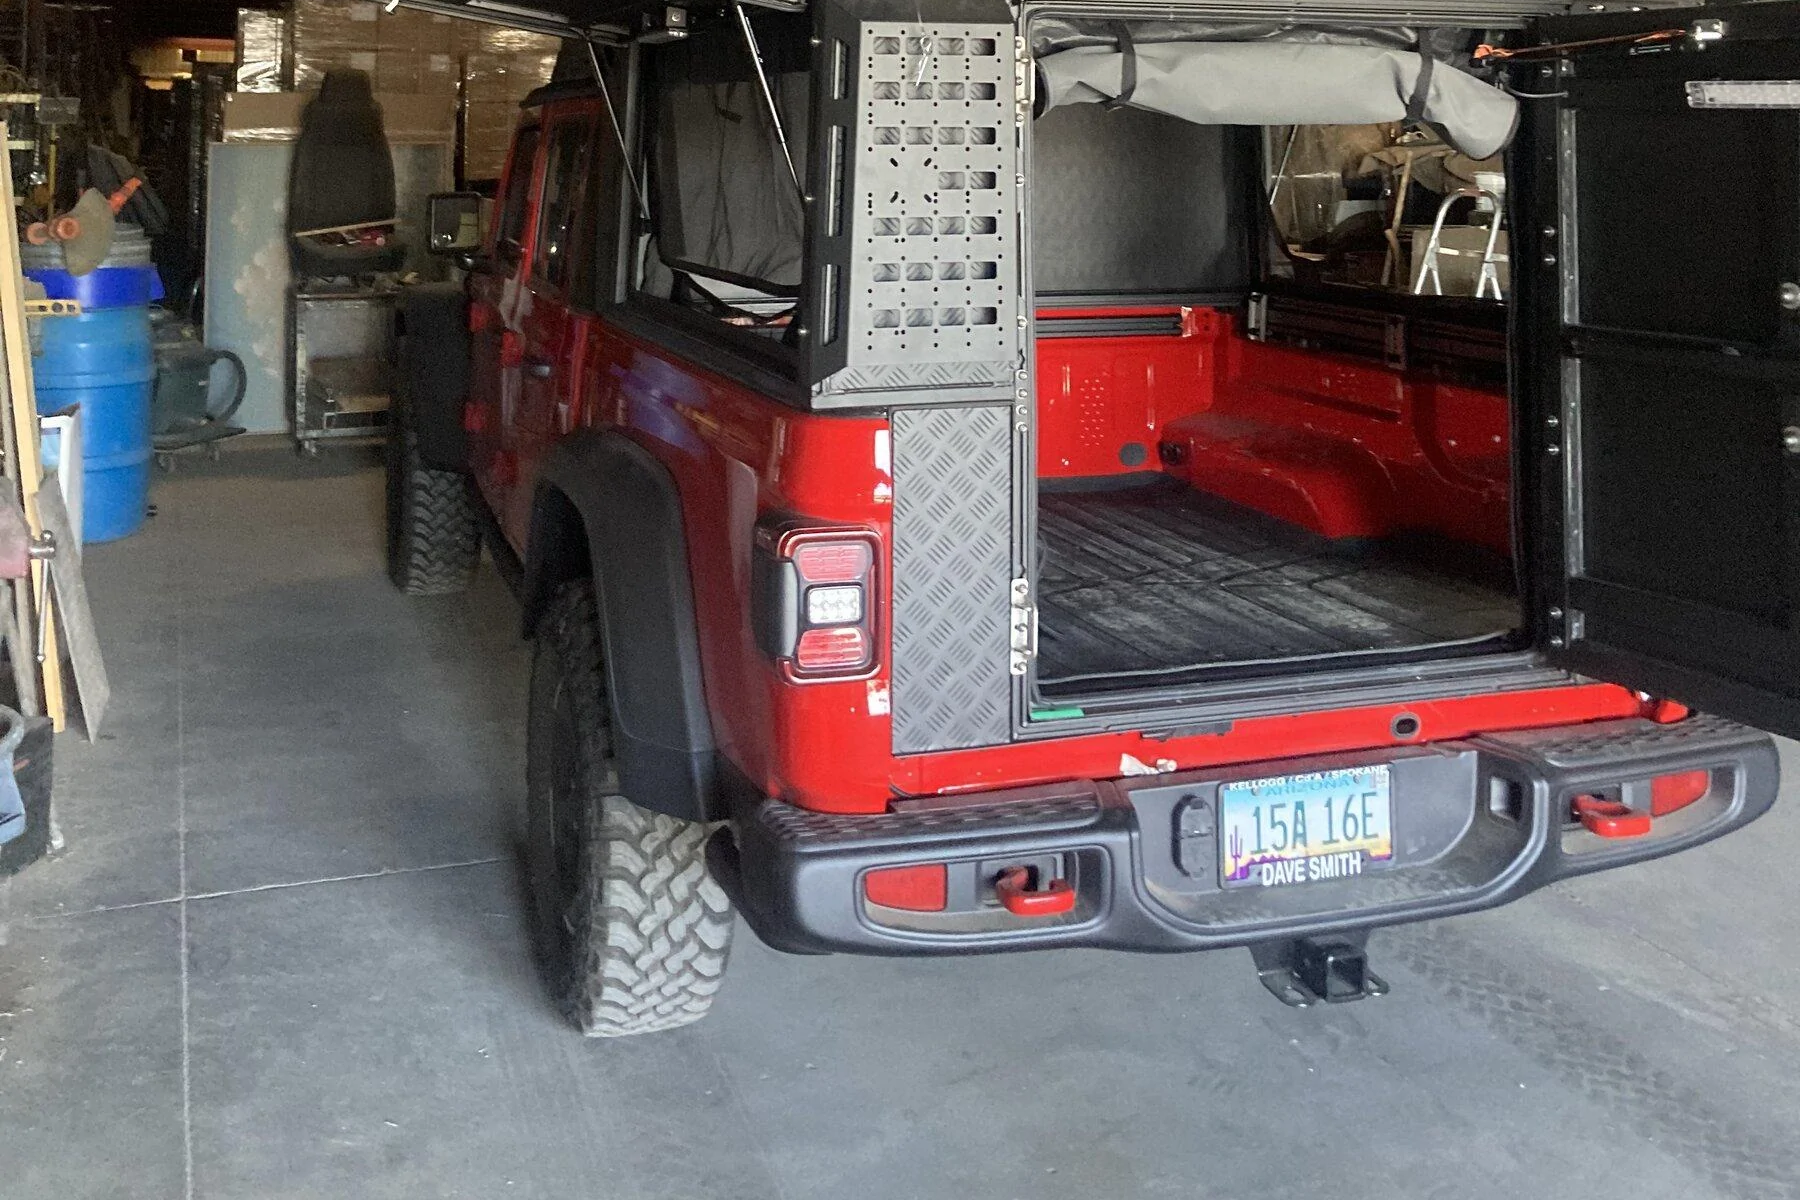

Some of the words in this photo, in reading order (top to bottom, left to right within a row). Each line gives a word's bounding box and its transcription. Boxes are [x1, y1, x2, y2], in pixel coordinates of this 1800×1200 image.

[1229, 777, 1286, 791] KELLOGG
[1331, 764, 1388, 779] SPOKANE
[1265, 779, 1350, 797] ARIZONA
[1250, 800, 1307, 854] 15A
[1322, 792, 1379, 846] 16E
[1262, 859, 1306, 886] DAVE
[1309, 851, 1361, 880] SMITH
